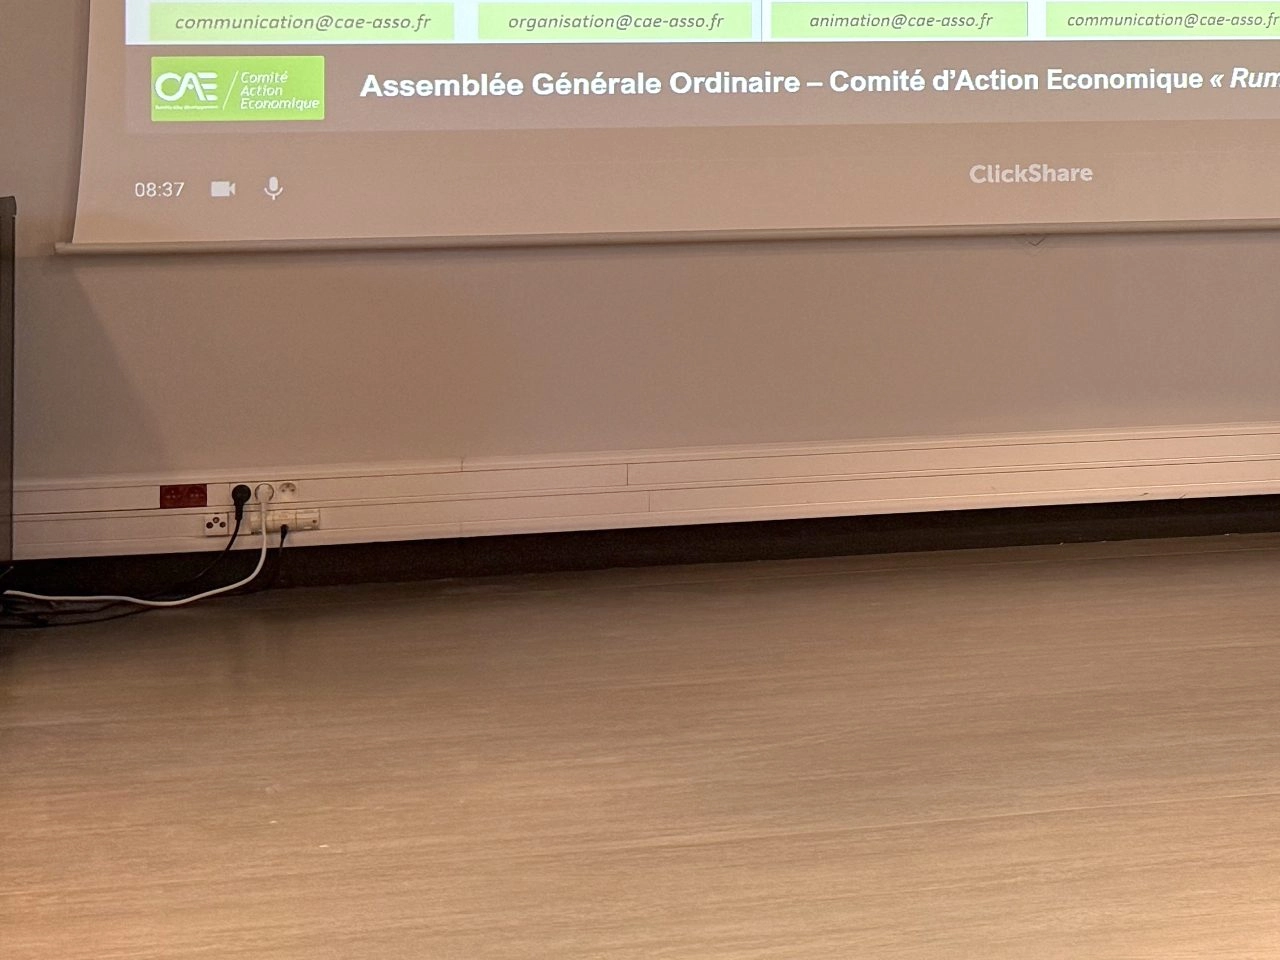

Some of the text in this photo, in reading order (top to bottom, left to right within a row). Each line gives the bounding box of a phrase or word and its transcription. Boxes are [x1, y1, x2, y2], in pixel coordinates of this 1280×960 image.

[174, 13, 432, 33] communication@cae-asso.fr
[507, 13, 725, 33] organisation@cae-asso.fr
[809, 11, 994, 31] animation@cae-asso.fr
[1066, 11, 1280, 30] communication@cae-asso.fr
[154, 72, 219, 102] CAE
[240, 70, 288, 84] Comité
[359, 71, 524, 99] Assemblée
[531, 70, 662, 97] Générale
[669, 70, 800, 96] Ordinaire
[829, 67, 927, 93] Comité
[932, 68, 1039, 92] d’Action
[1046, 68, 1204, 96] Economique
[240, 85, 283, 97] Action
[240, 97, 320, 112] Economique
[969, 164, 1093, 185] ClickShare
[134, 181, 185, 199] 08:37
